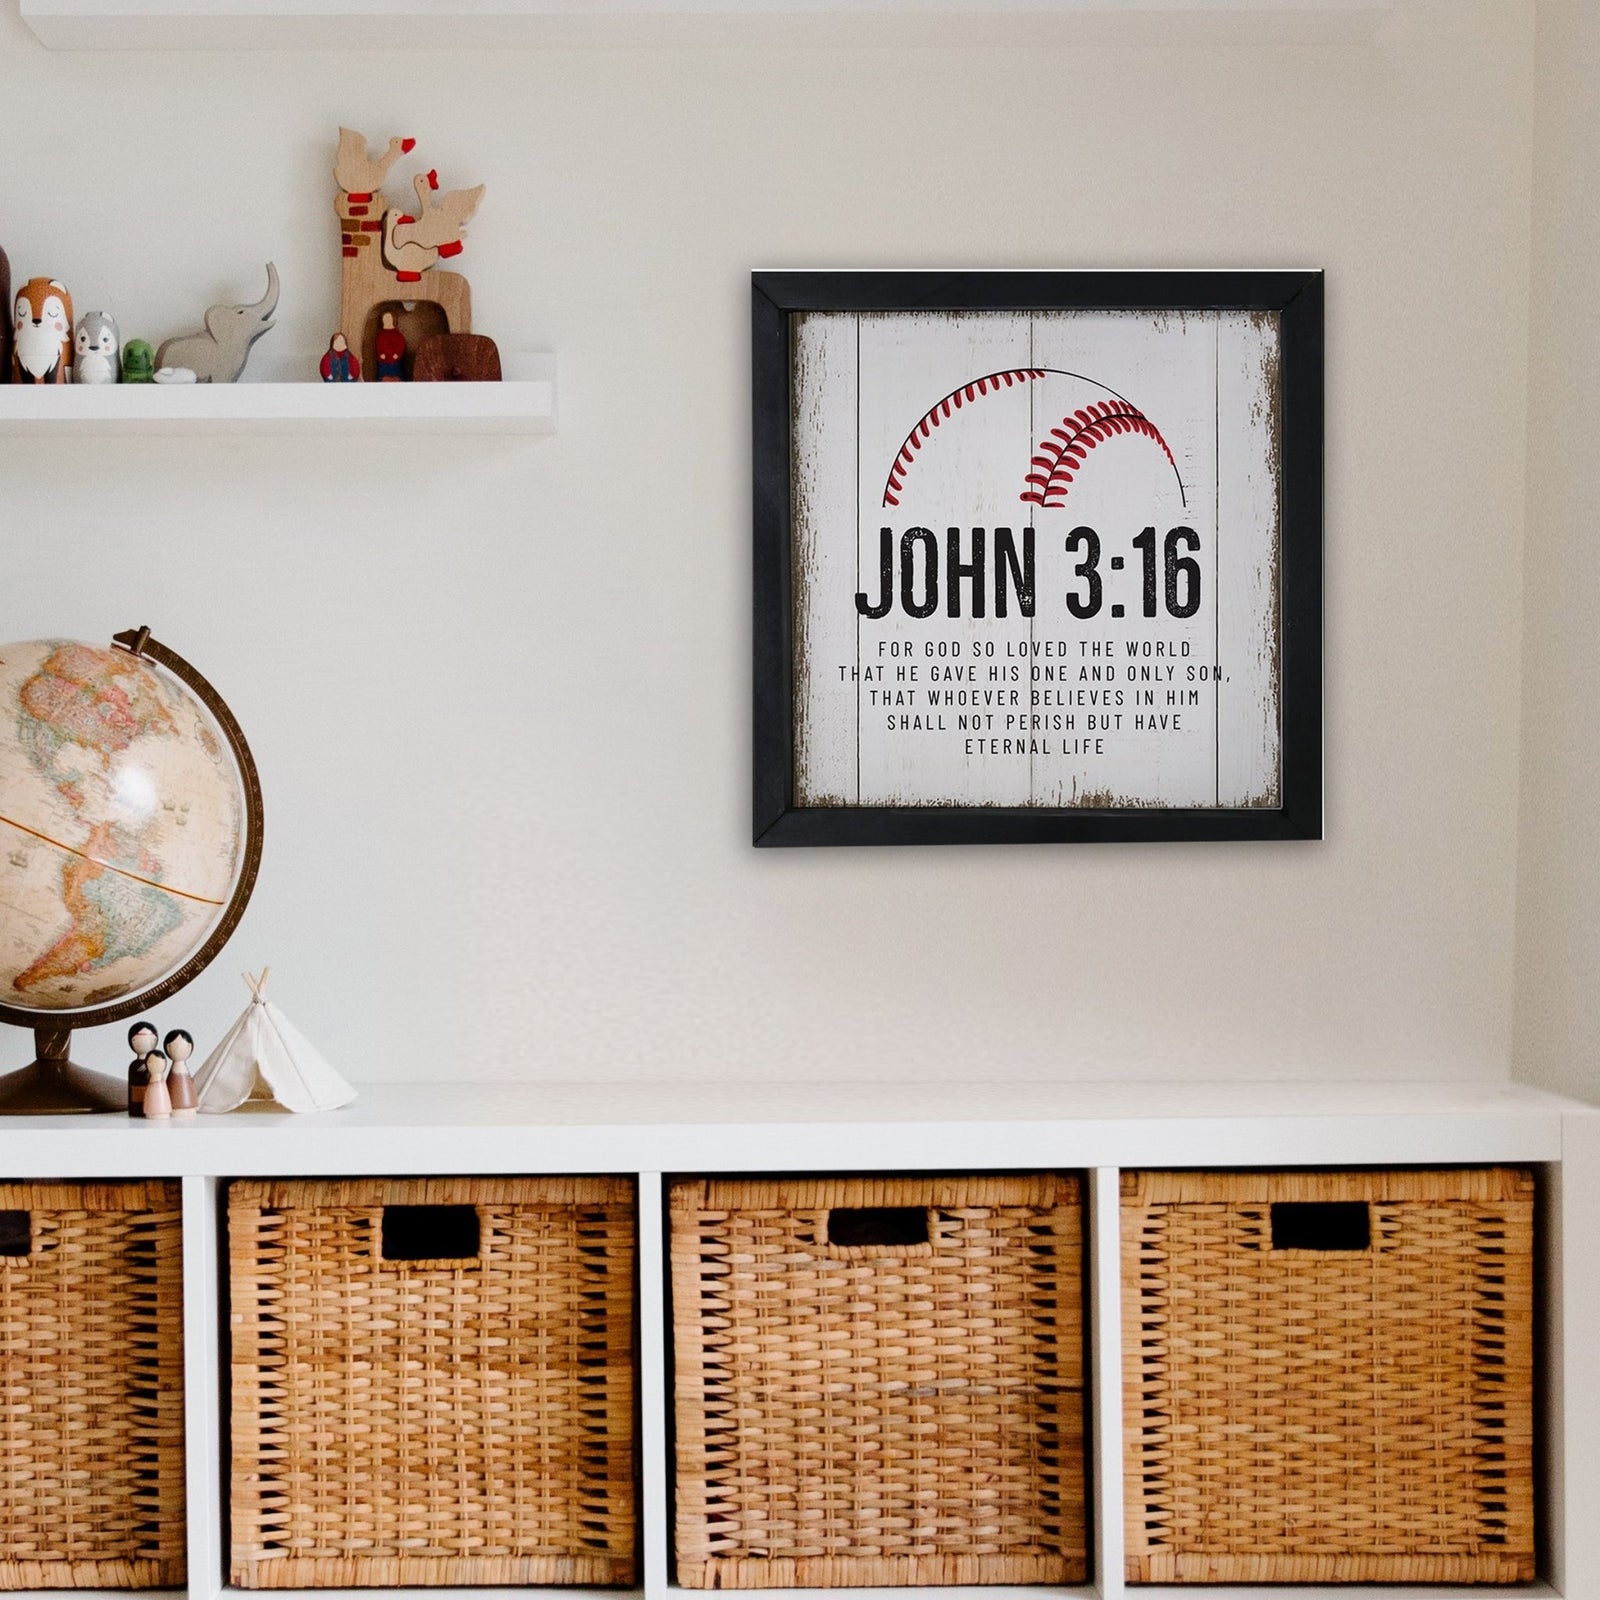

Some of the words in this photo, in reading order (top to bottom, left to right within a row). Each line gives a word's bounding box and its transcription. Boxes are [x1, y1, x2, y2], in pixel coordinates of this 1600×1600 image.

[855, 527, 1036, 619] JOHN
[1065, 526, 1201, 619] 3:16
[878, 642, 914, 657] FOR
[925, 641, 961, 657] GOD
[972, 641, 996, 657] SO
[1007, 641, 1068, 657] LOVED
[1080, 641, 1114, 657] THE
[1126, 641, 1191, 657] WORLD
[839, 666, 884, 682] THAT
[896, 666, 919, 682] HE
[930, 666, 977, 682] GAVE
[989, 666, 1020, 682] HIS
[1031, 666, 1068, 682] ONE
[1079, 666, 1116, 682] AND
[1127, 666, 1174, 682] ONLY
[1186, 666, 1231, 684] SON,
[870, 690, 916, 706] THAT
[928, 690, 1020, 706] WHOEVER
[1031, 690, 1125, 706] BELIEVES
[1136, 690, 1154, 706] IN
[1166, 690, 1199, 706] HIM
[887, 715, 947, 731] SHALL
[958, 715, 994, 731] NOT
[1006, 715, 1075, 730] PERISH
[1087, 715, 1123, 730] BUT
[1135, 715, 1182, 730] HAVE
[965, 739, 1051, 755] ETERNAL
[1063, 739, 1105, 755] LIFE
